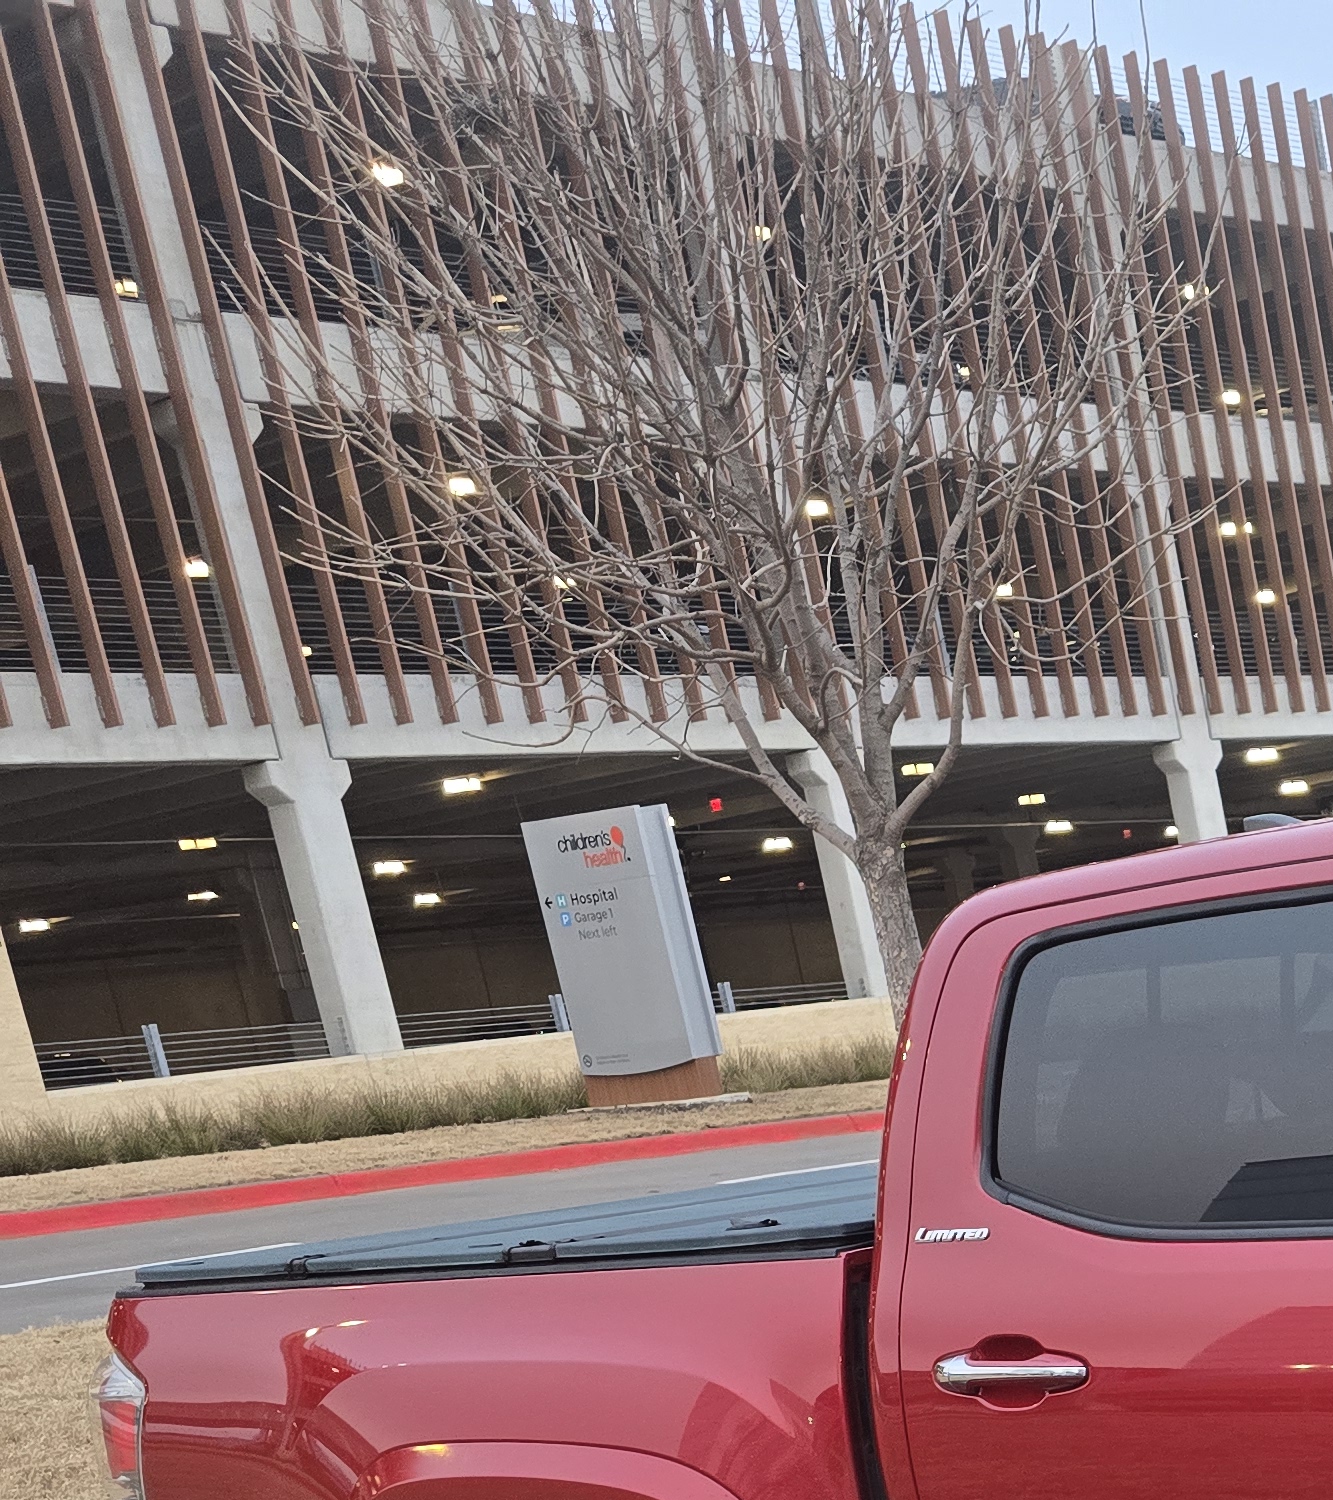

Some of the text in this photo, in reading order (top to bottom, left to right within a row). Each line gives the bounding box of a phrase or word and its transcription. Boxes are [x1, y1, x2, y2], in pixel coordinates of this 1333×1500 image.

[557, 830, 611, 853] children's
[583, 847, 623, 868] health
[570, 887, 618, 906] Hospital
[574, 910, 608, 923] Garage
[608, 907, 614, 918] 1
[578, 925, 618, 940] Next left
[914, 1227, 990, 1243] LIMITED
